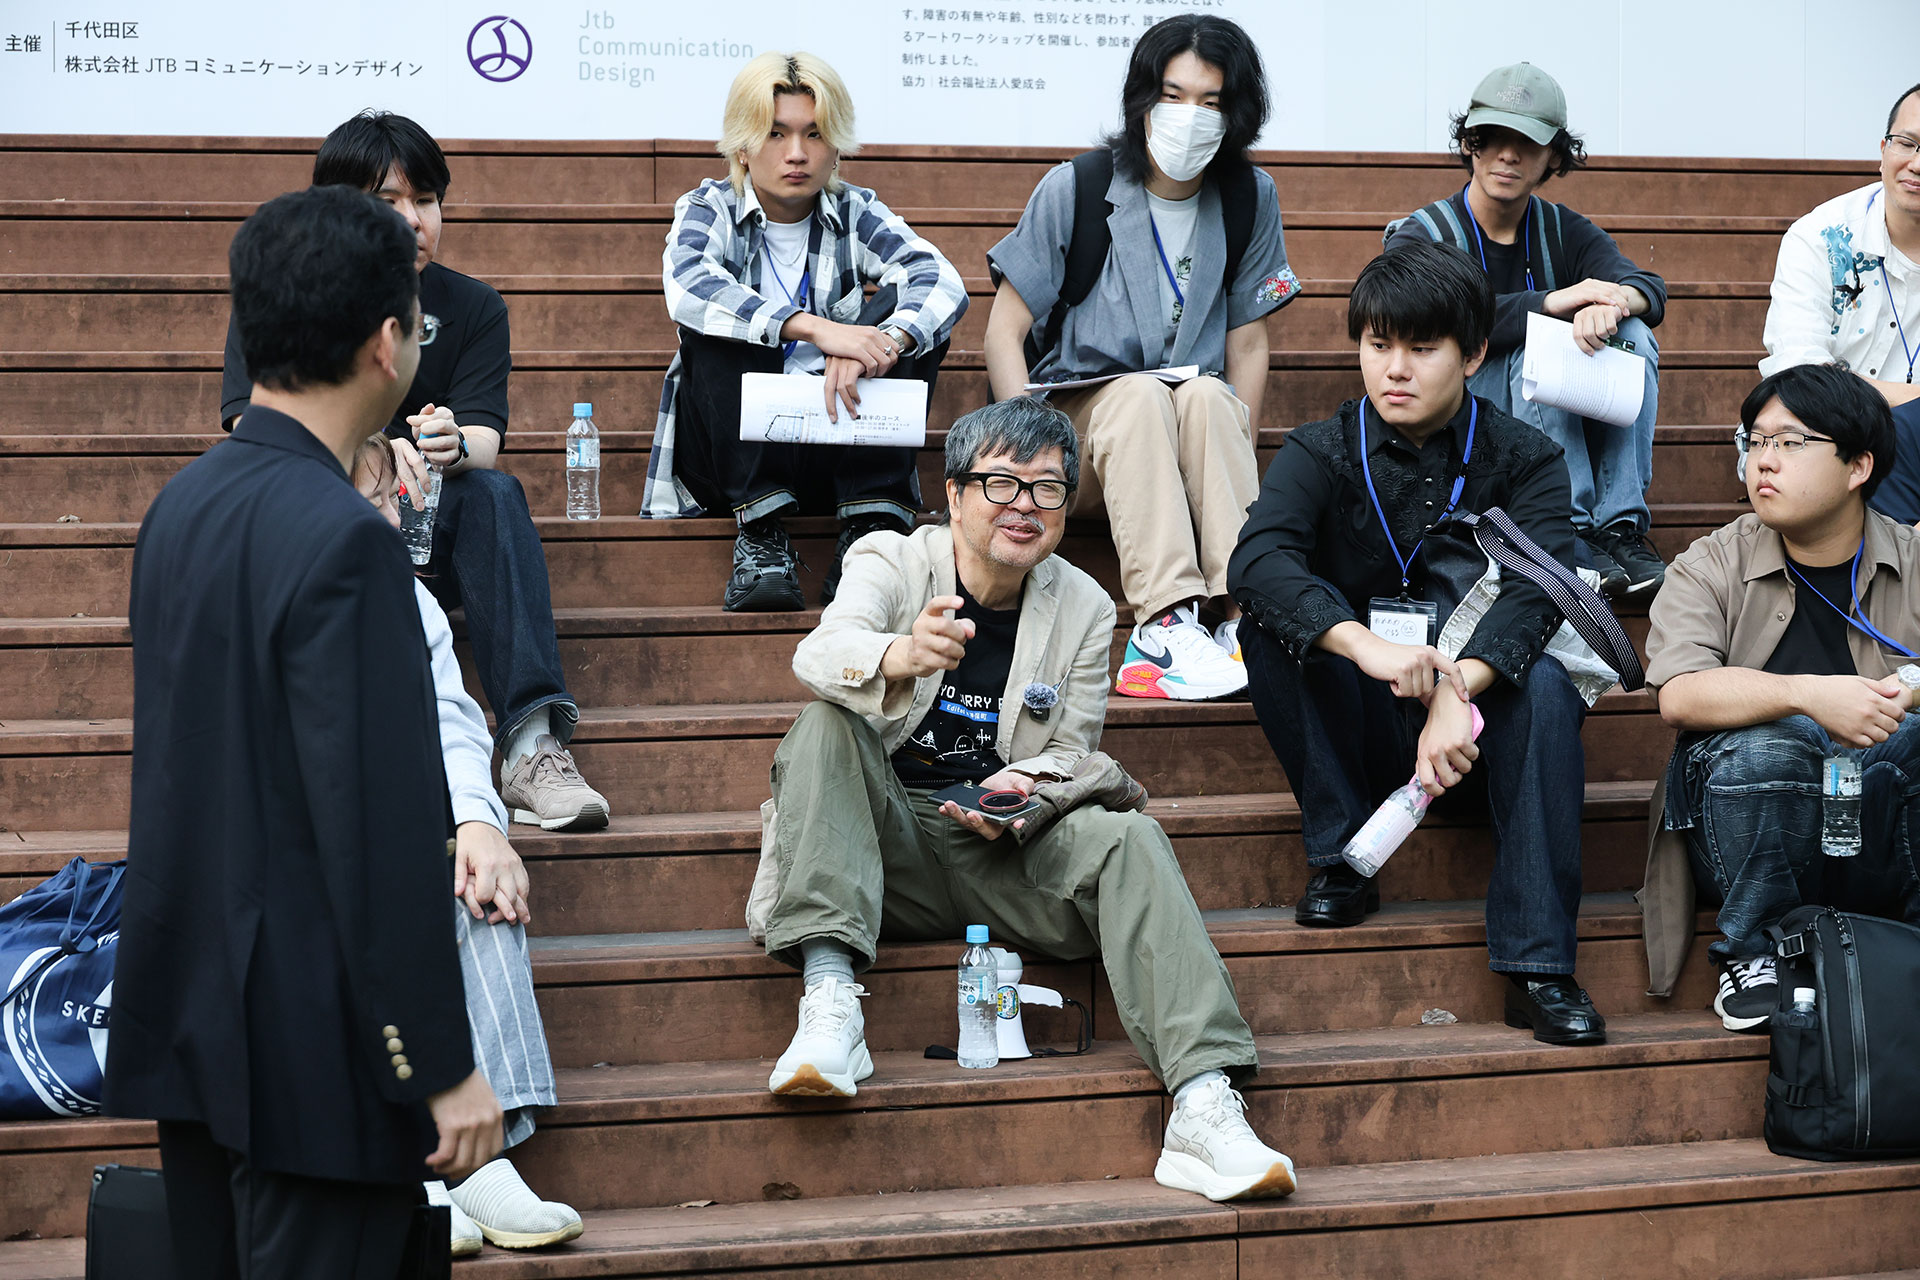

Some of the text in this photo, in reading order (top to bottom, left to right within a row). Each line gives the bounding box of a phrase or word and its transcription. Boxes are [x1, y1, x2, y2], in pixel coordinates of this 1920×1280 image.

[579, 10, 614, 29] Jtb
[65, 21, 139, 39] 千代田区
[5, 34, 41, 53] 主催
[579, 36, 754, 58] Communication
[65, 55, 423, 77] 株式会社 JTB コミュニケーションデザイン
[902, 53, 978, 67] 制作しました。
[579, 62, 655, 88] Design
[902, 75, 925, 88] 協力
[61, 1000, 110, 1025] SKE
